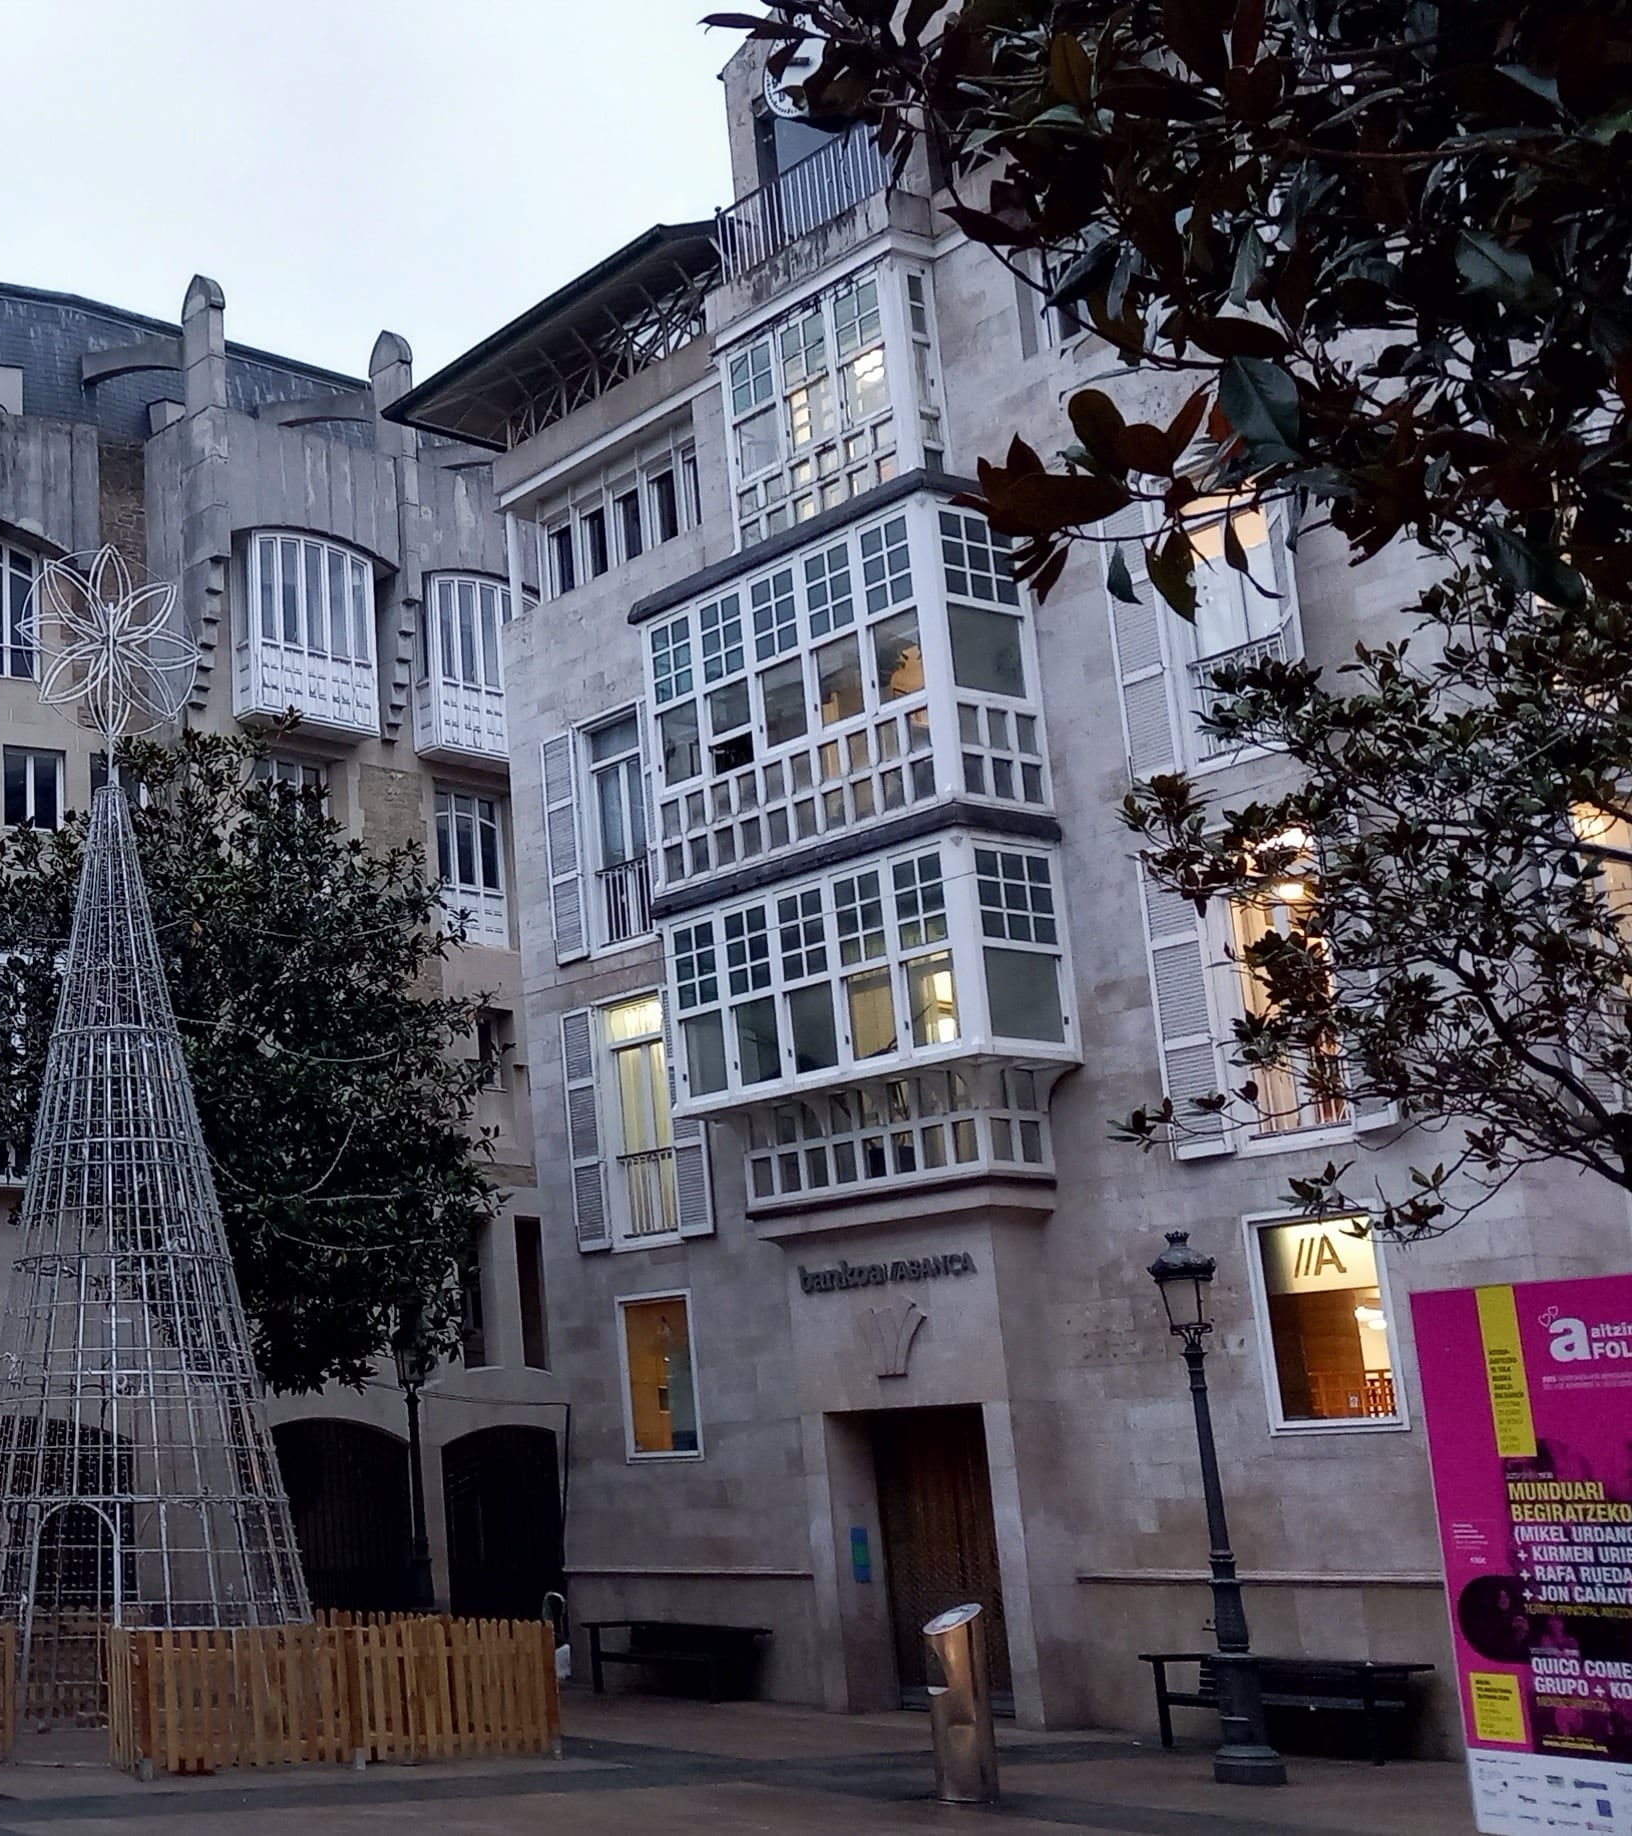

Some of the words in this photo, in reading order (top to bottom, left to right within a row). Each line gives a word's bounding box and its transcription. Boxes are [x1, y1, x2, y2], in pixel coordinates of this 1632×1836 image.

[1508, 1482, 1605, 1501] MUNDUARI
[1511, 1503, 1632, 1523] BEGIRATZEKO
[1514, 1525, 1569, 1545] (MIKEL
[1532, 1545, 1594, 1562] KIRMEN
[1534, 1565, 1576, 1582] RAFA
[1578, 1566, 1632, 1583] RUEDA
[1537, 1585, 1569, 1602] JON
[1531, 1656, 1580, 1677] QUICO
[1534, 1676, 1589, 1697] GRUPO
